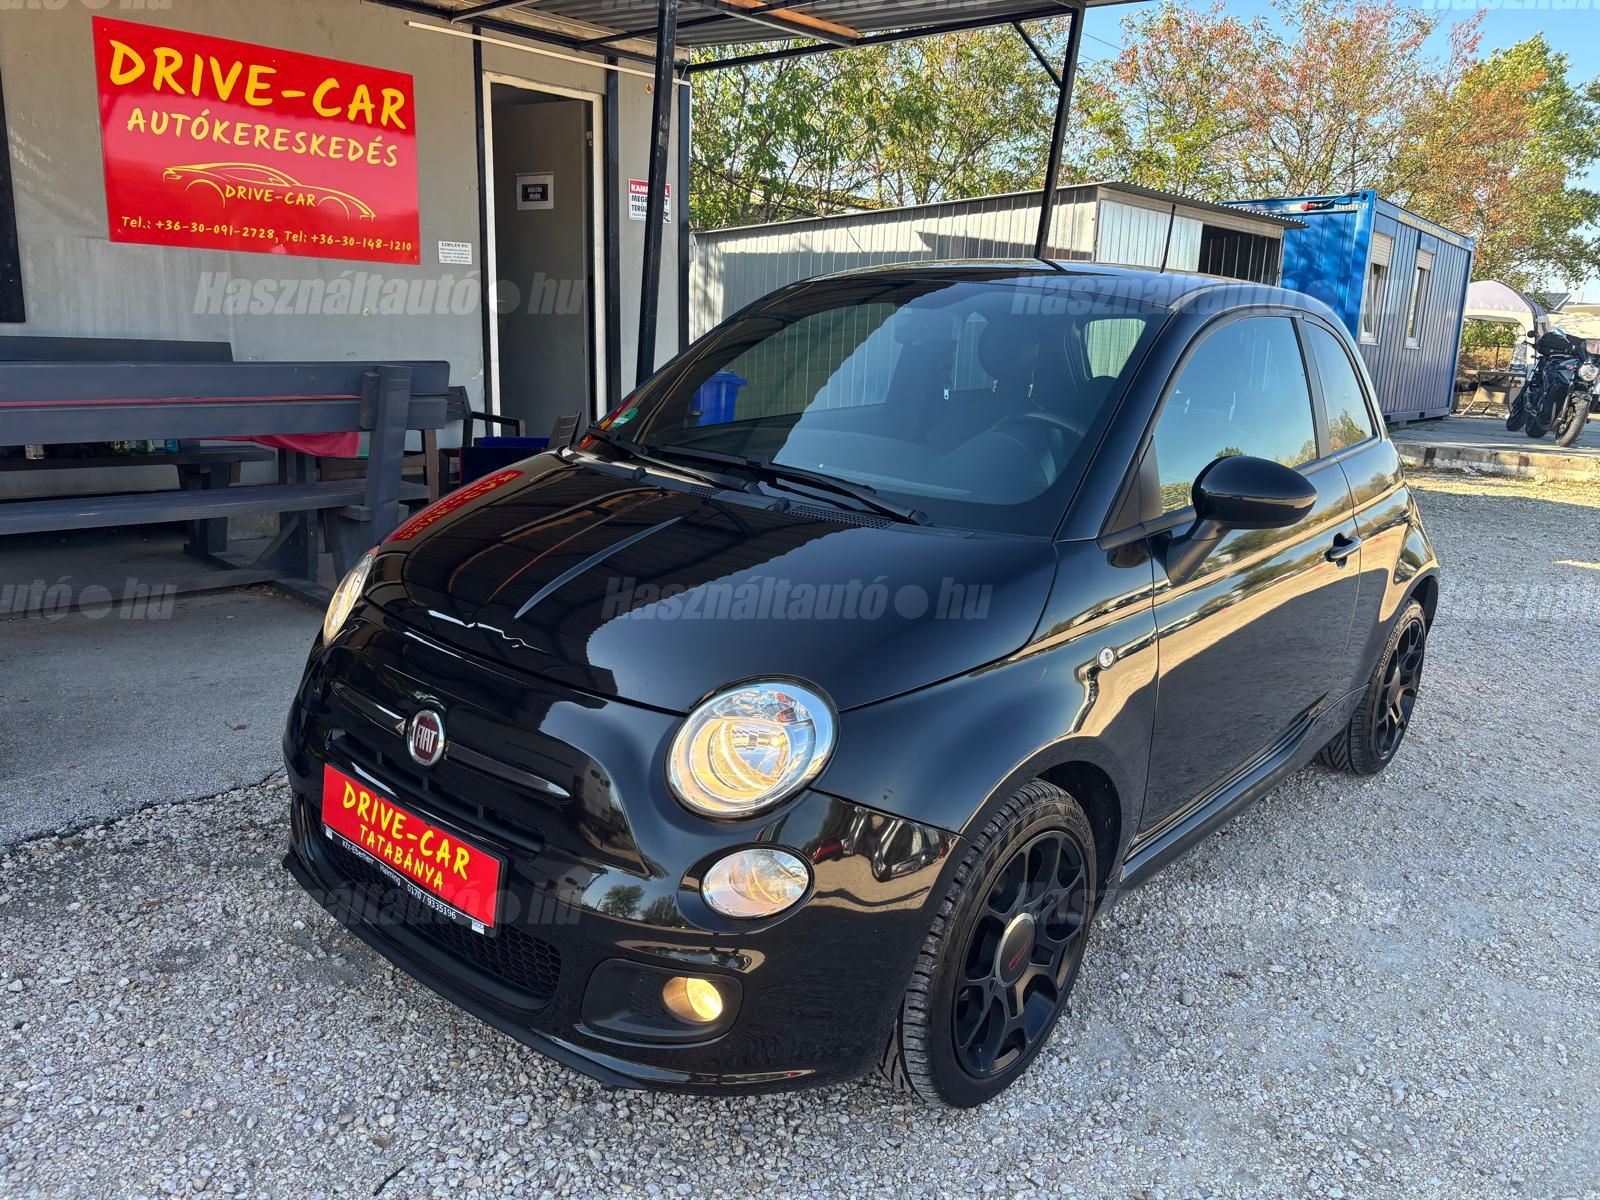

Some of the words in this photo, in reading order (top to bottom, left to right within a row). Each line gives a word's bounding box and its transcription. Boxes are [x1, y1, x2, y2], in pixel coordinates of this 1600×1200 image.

[109, 39, 407, 130] DRIVE-CAR
[126, 107, 398, 167] AUTÓKERESKEDÉS
[224, 184, 316, 208] DRIVE-CAR
[121, 215, 151, 230] Tel.:
[155, 219, 280, 245] +36-30-091-2728,
[284, 230, 307, 244] Tel:
[310, 232, 412, 252] +36-30-148-1210
[414, 725, 438, 753] FIAT
[342, 781, 471, 880] DRIVE-CAR
[359, 824, 444, 891] TATABÁNYA
[407, 883, 422, 900] 0170
[427, 896, 457, 920] 9335196
